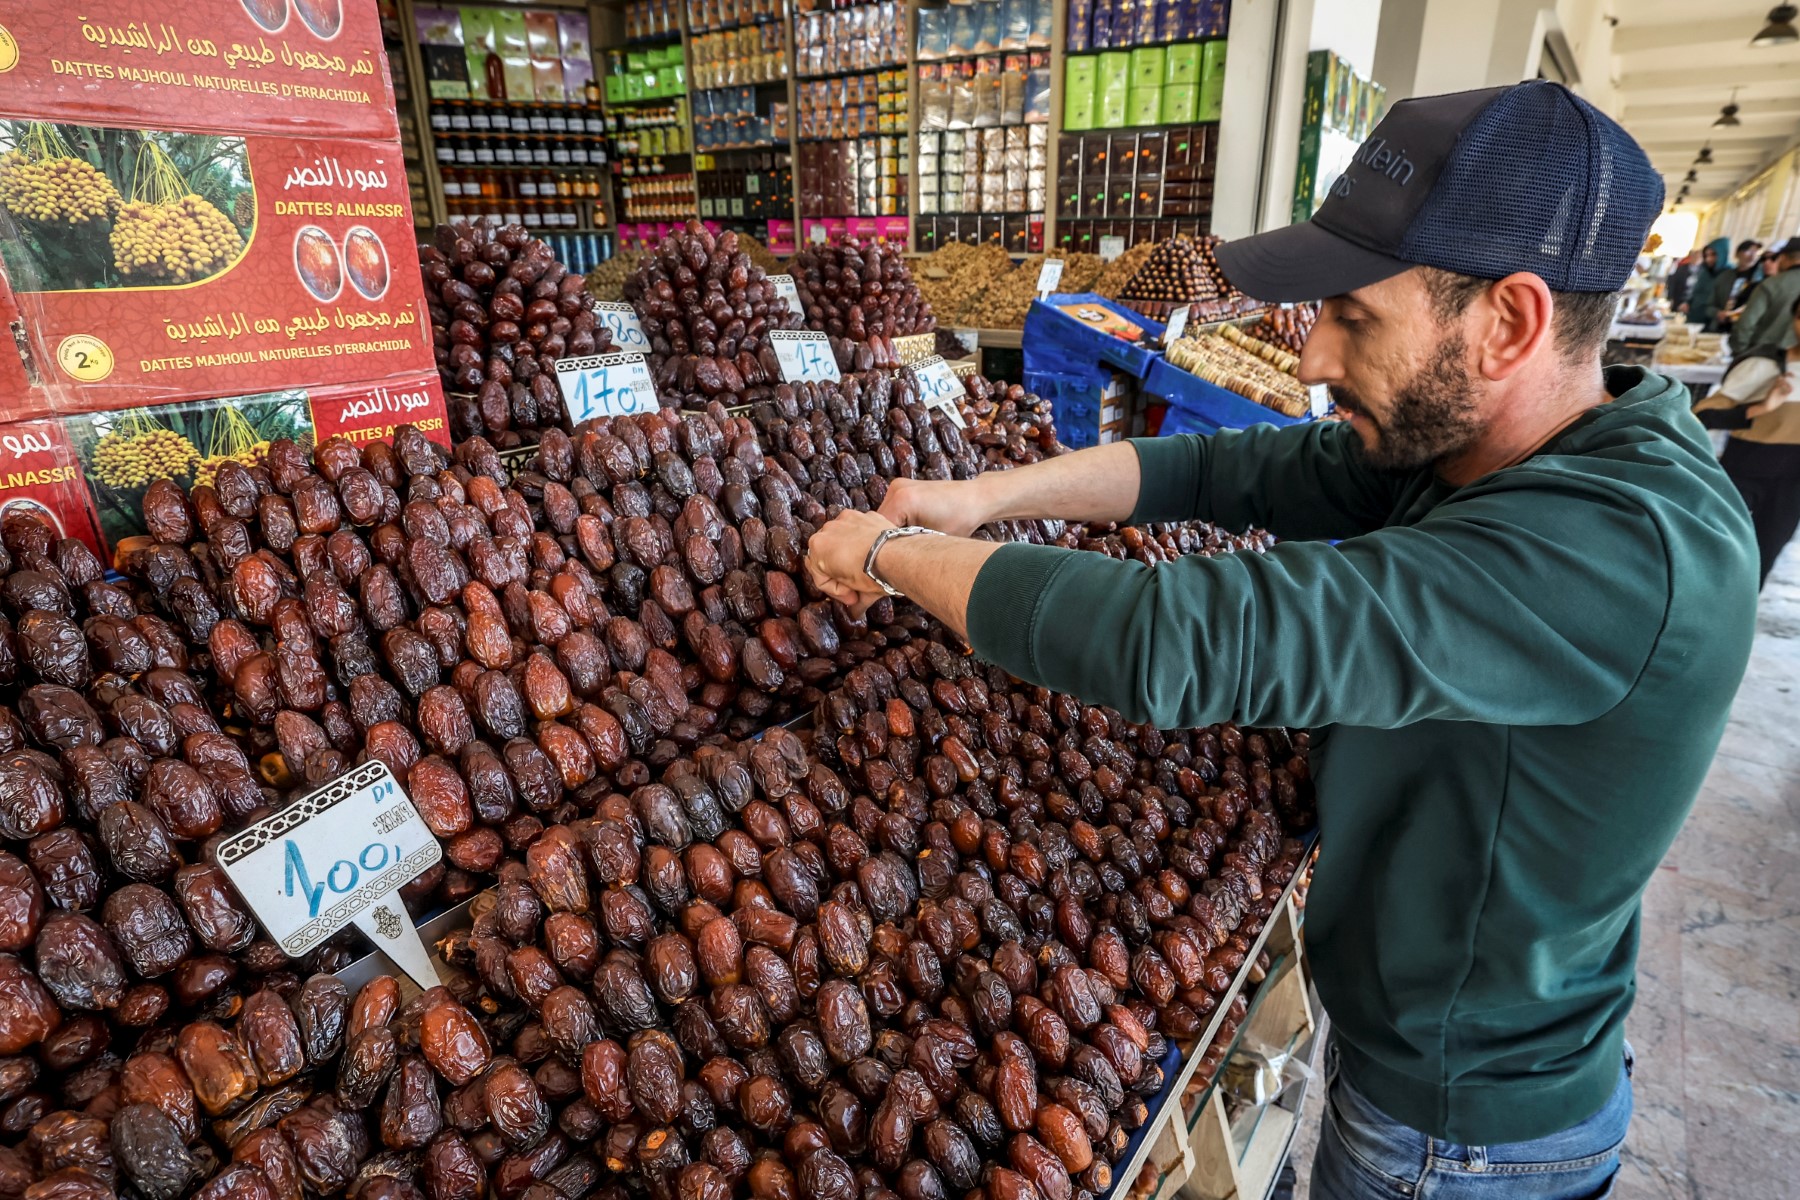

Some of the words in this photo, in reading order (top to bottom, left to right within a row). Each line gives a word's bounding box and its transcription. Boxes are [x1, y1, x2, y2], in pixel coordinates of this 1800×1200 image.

[78, 16, 183, 55] الراشيدية
[187, 37, 217, 57] من
[223, 37, 275, 69] طبيعي
[280, 40, 346, 76] مجهول
[349, 50, 374, 77] تمر
[51, 59, 115, 79] DATTES
[117, 66, 192, 87] MAJHOUL
[193, 74, 279, 96] NATURELLES
[281, 83, 371, 104] D'ERRACHIDIA
[275, 201, 333, 216] DATTES
[336, 203, 403, 217] ALNASSR
[162, 312, 251, 344] الراشيدية
[254, 318, 280, 334] من
[285, 307, 330, 341] طبيعي
[334, 307, 391, 331] مجهول
[393, 303, 415, 329] تمر
[75, 352, 91, 369] 2
[140, 356, 193, 373] DATTES
[195, 351, 258, 368] MAJHOUL
[258, 345, 333, 362] NATURELLES
[334, 339, 412, 356] D'ERRACHIDIA
[385, 418, 443, 437] AASSR
